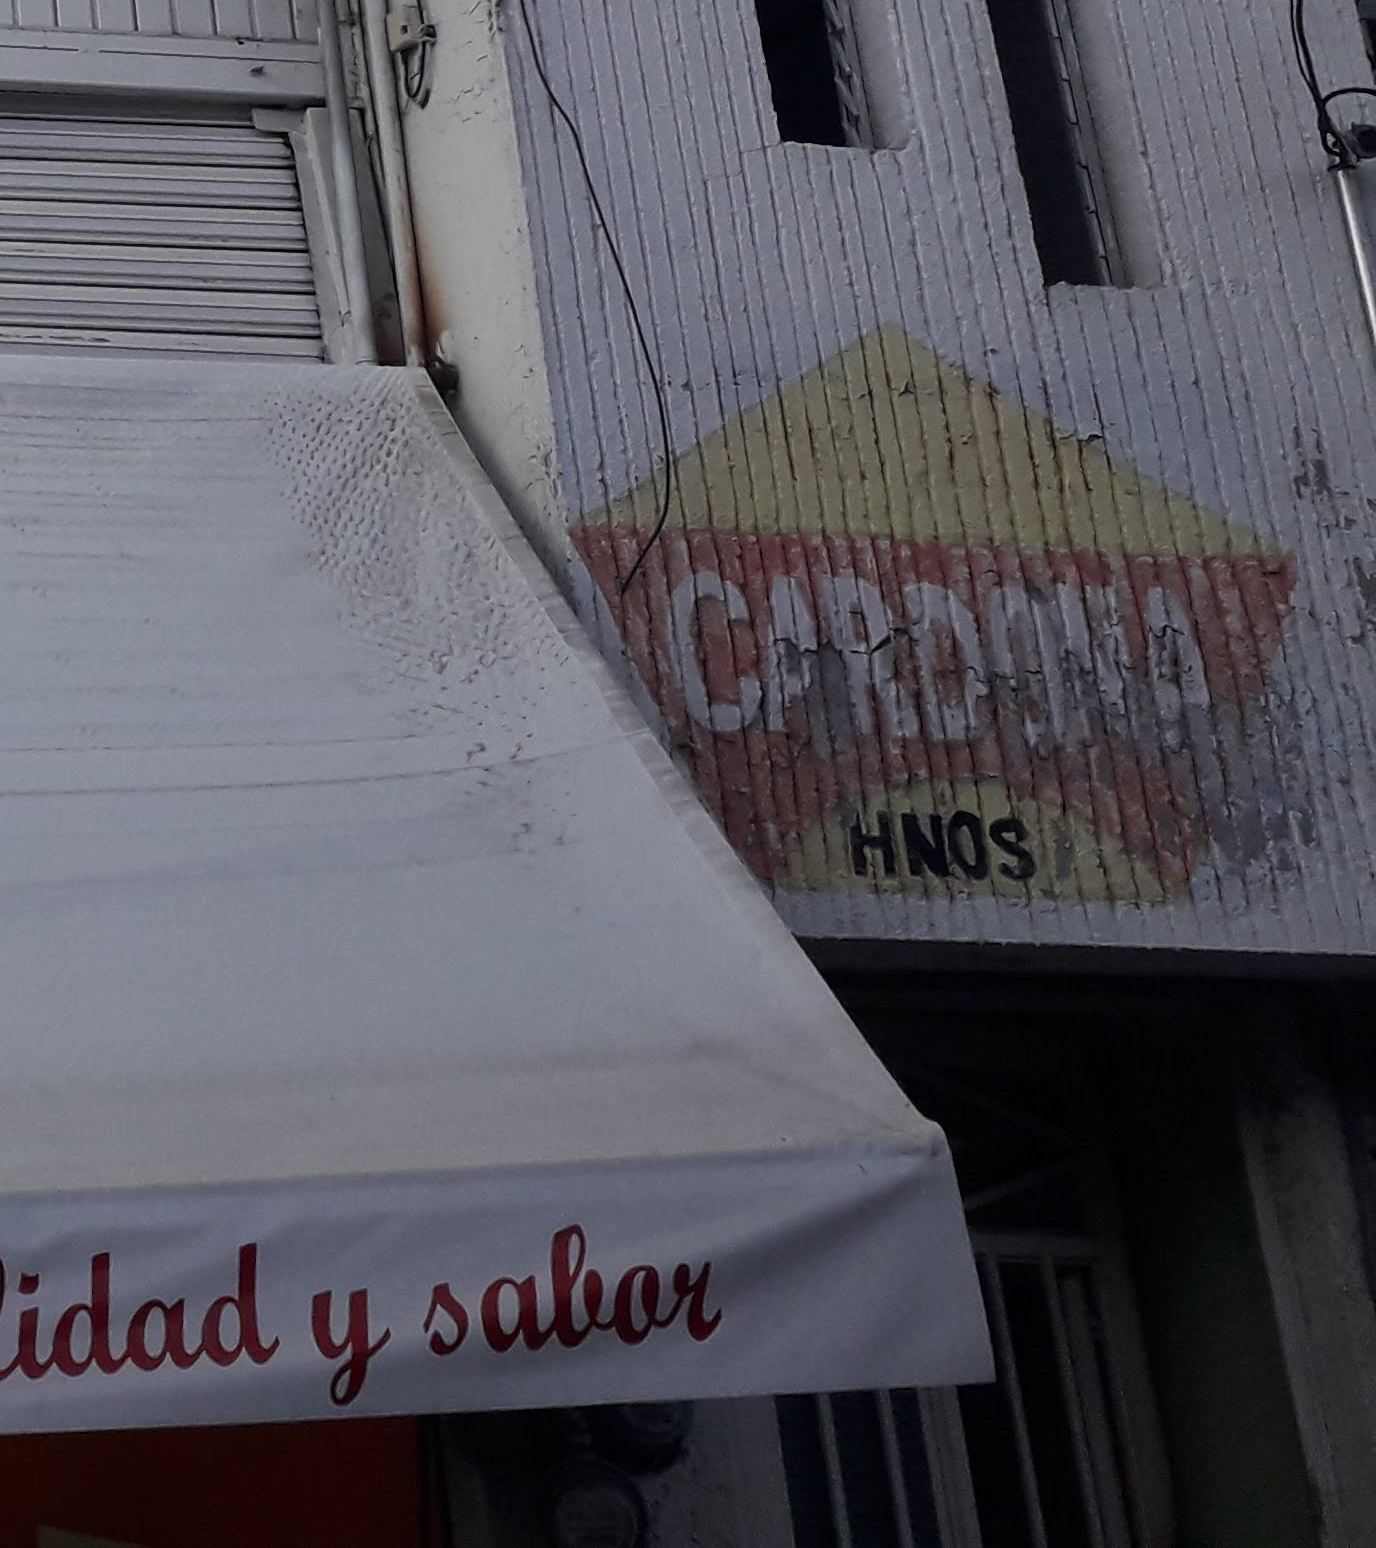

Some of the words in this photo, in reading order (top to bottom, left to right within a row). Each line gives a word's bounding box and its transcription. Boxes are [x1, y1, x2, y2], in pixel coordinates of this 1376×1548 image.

[848, 807, 1039, 882] HNOS
[309, 1287, 392, 1407] y
[422, 1222, 724, 1354] sabor
